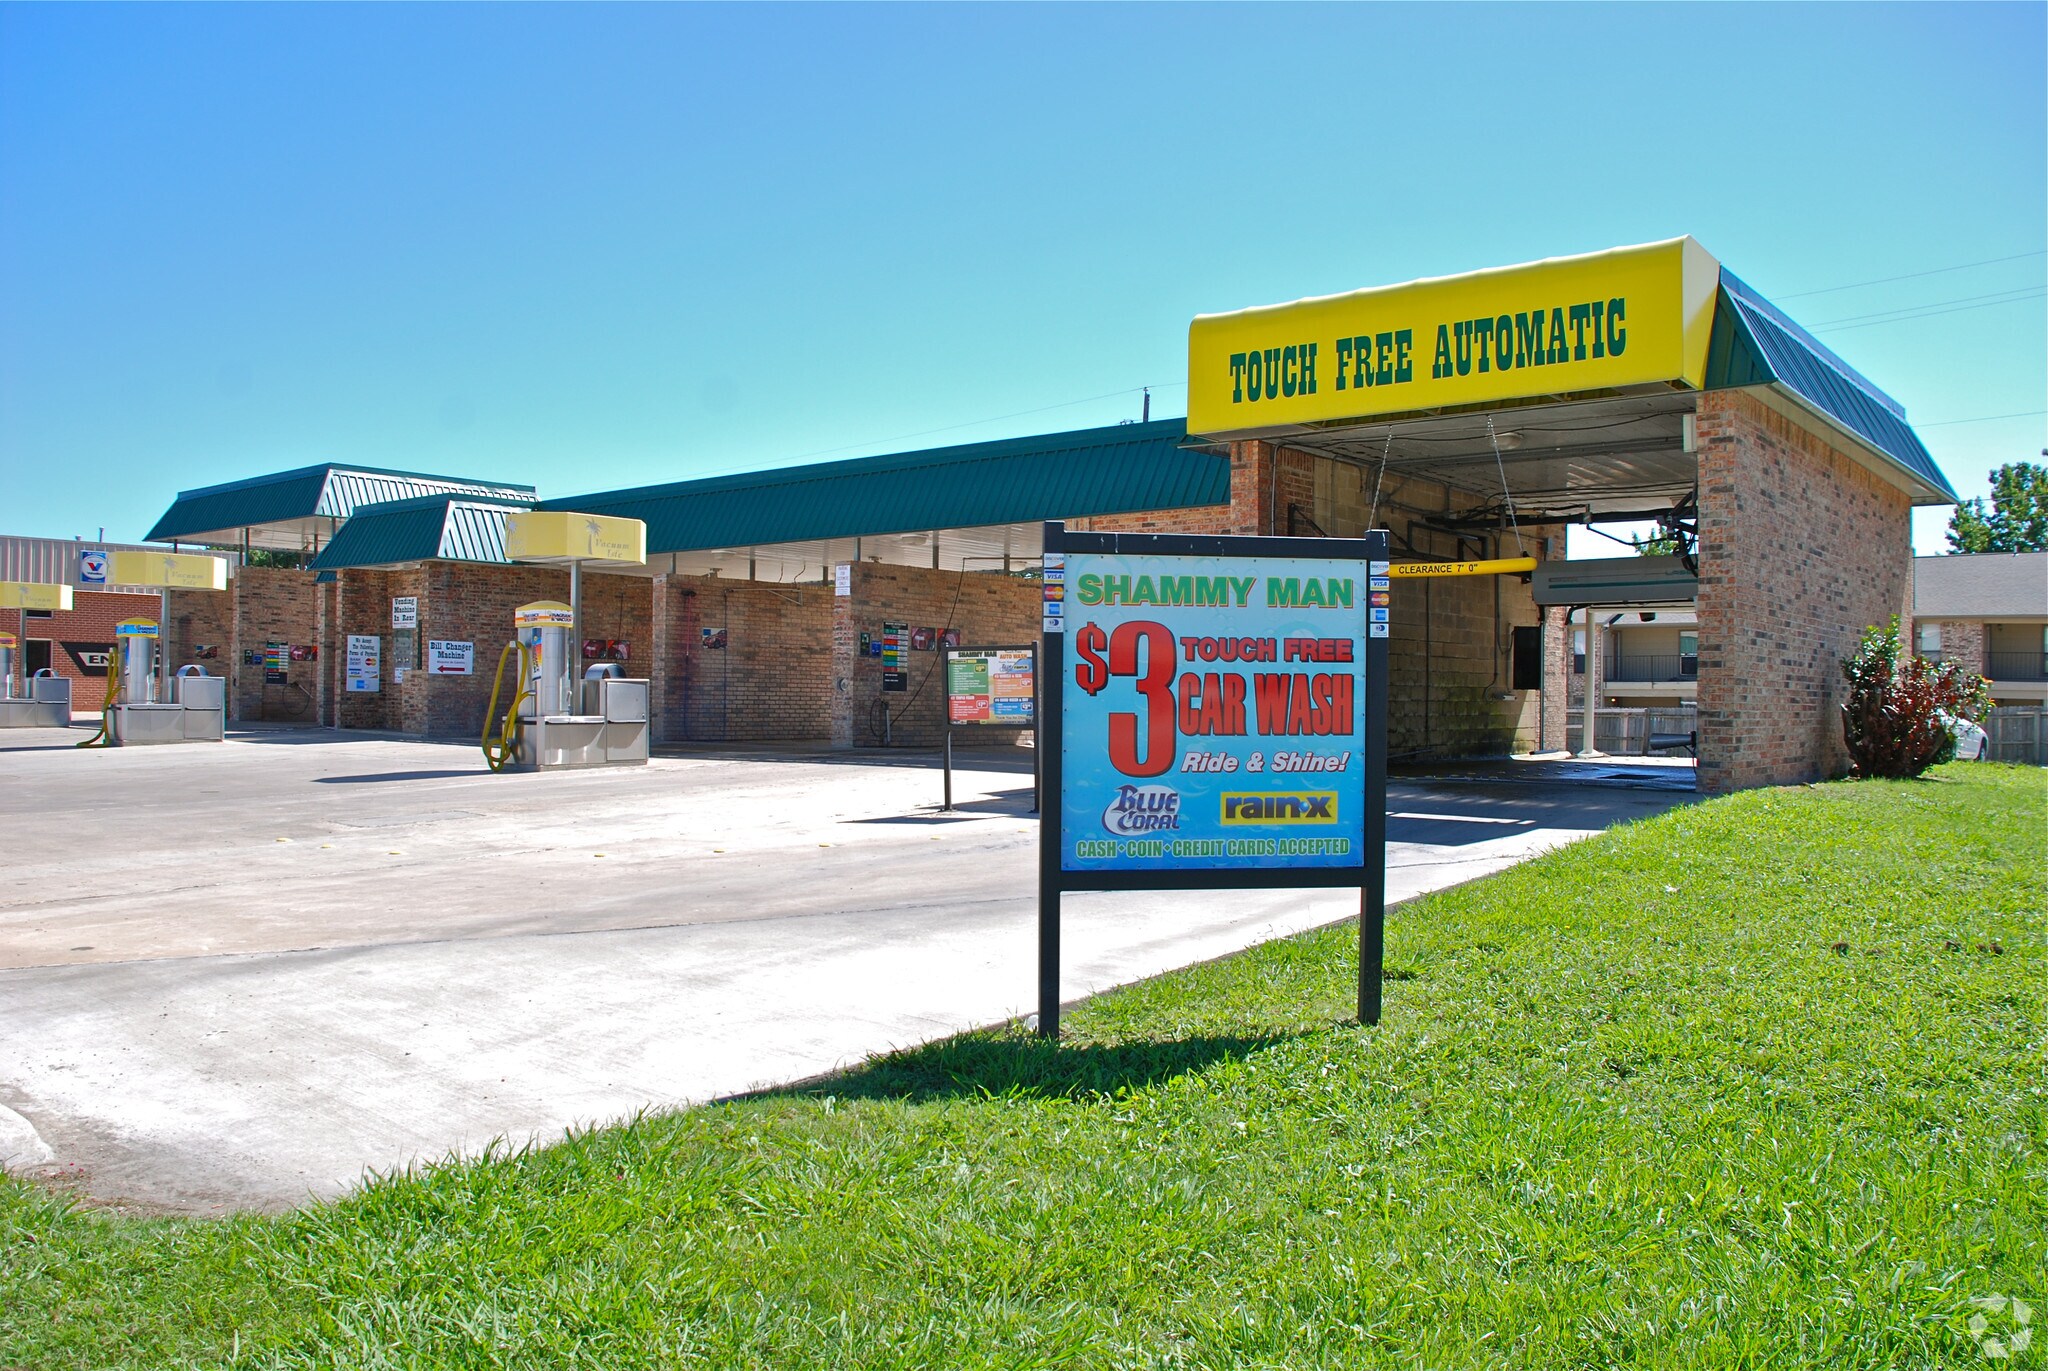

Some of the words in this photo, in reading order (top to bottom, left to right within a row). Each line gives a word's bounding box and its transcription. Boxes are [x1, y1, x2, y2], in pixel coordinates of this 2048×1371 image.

[1230, 343, 1318, 403] TOUCH
[1335, 329, 1412, 391] FREE
[1432, 297, 1626, 379] AUTOMATIC
[595, 538, 630, 550] Vacuum
[1398, 564, 1452, 575] CLEARANCE
[1456, 563, 1465, 573] 7'
[394, 598, 415, 606] Vending
[1076, 574, 1256, 608] SHAMMY
[1266, 577, 1354, 610] MAN
[430, 642, 442, 650] Bill
[446, 643, 472, 652] Changer
[437, 651, 465, 660] Machine
[1180, 637, 1277, 662] TOUCH
[1283, 638, 1354, 662] FREE
[1076, 620, 1178, 777] $3
[1178, 672, 1248, 736] CAR
[1254, 673, 1355, 736] WASH
[1180, 752, 1239, 773] Ride
[1245, 753, 1265, 773] &
[1270, 752, 1351, 773] Shine!
[1114, 785, 1178, 813] BLUE
[1117, 809, 1180, 831] CORAL
[1172, 840, 1225, 858] CREDIT
[1227, 839, 1276, 858] CARDS
[1278, 838, 1351, 857] ACCEPTED
